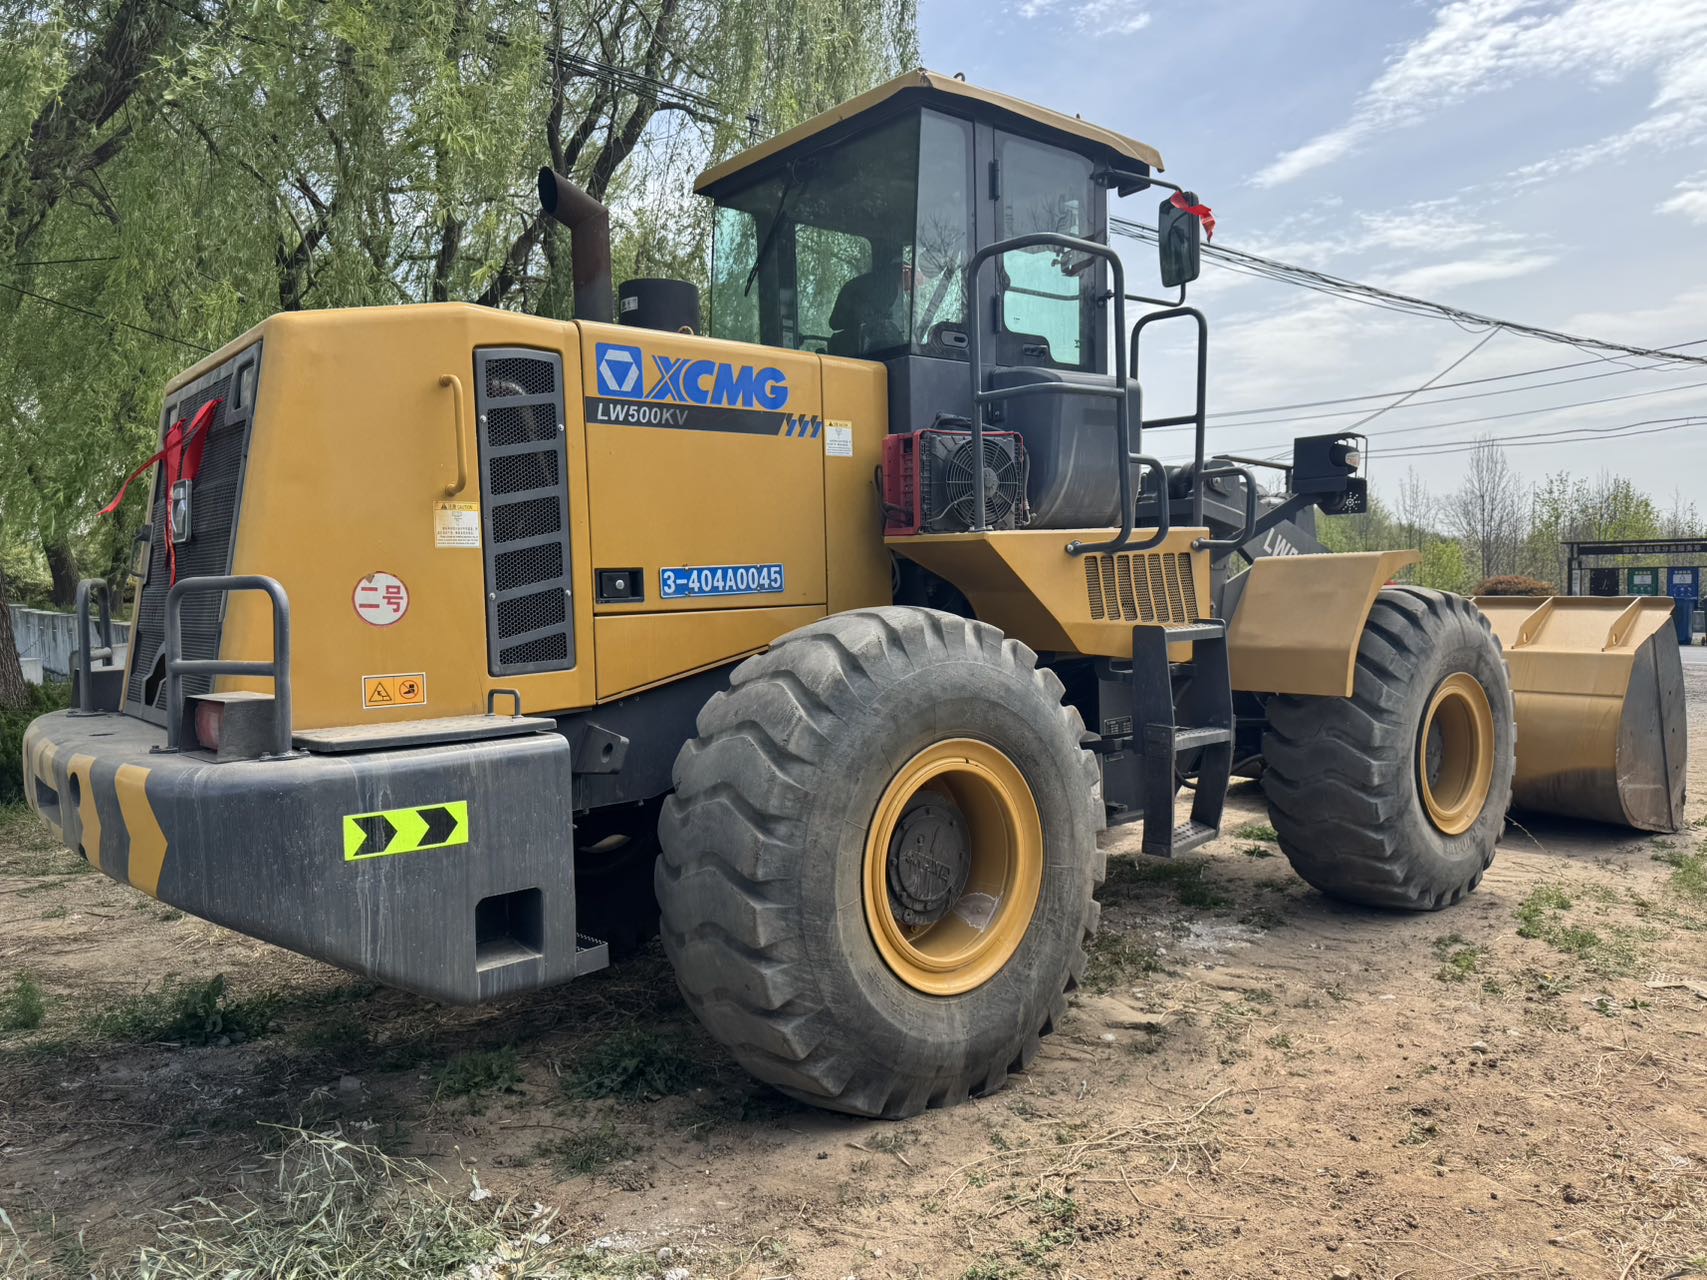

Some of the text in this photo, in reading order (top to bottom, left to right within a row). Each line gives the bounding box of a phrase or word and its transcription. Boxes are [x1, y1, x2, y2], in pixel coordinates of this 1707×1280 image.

[645, 354, 790, 411] XCMG
[596, 402, 689, 426] LW500KV
[663, 566, 782, 594] 3-404A0045
[358, 585, 404, 613] 二号
